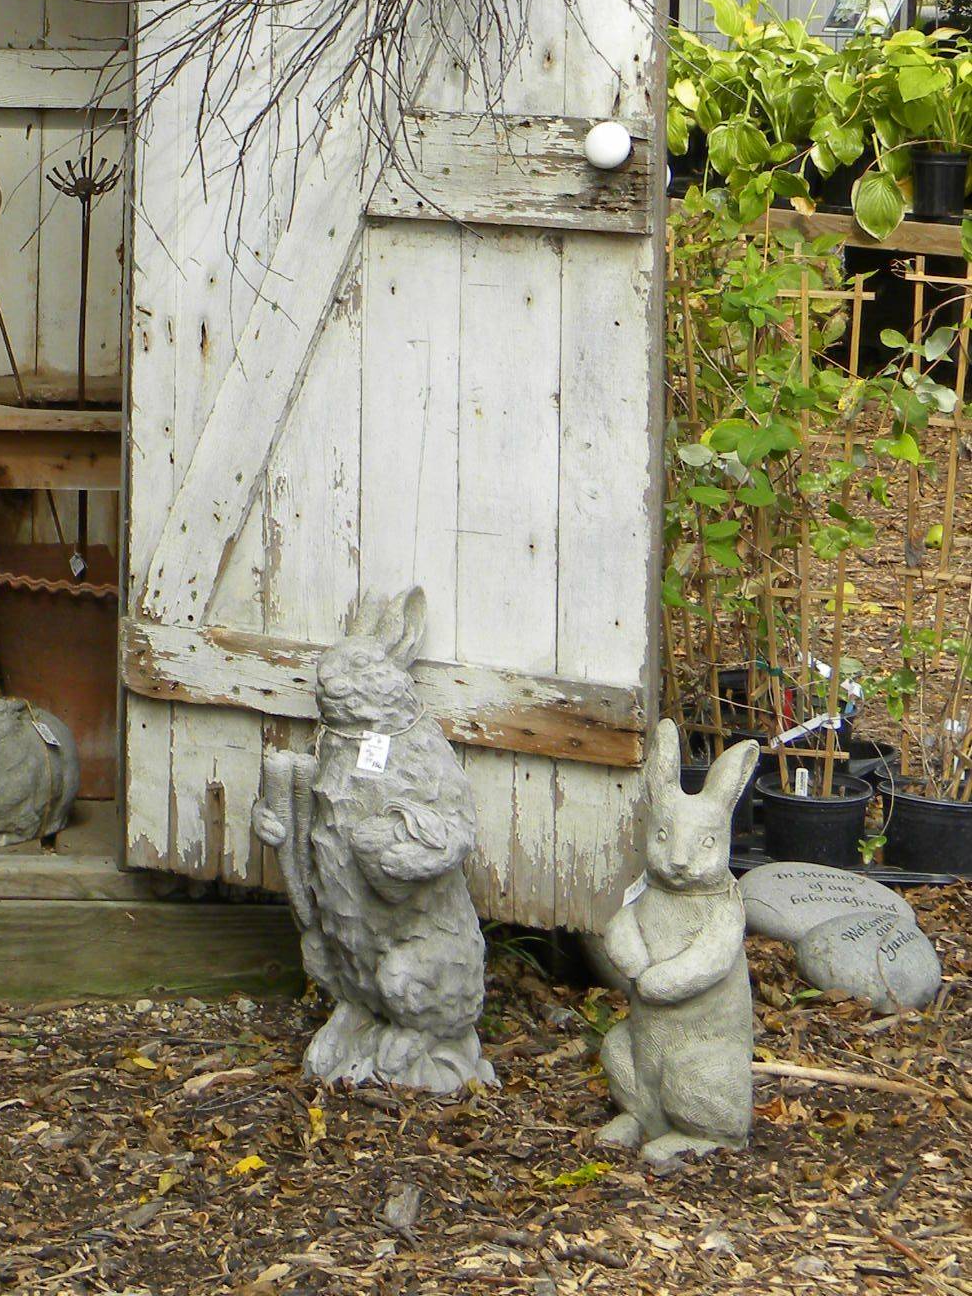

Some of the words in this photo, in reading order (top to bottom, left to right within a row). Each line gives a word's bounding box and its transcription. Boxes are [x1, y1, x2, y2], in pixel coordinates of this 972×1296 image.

[773, 872, 793, 880] In
[797, 871, 866, 885] Memory
[809, 882, 824, 892] of
[828, 884, 855, 893] our
[791, 894, 852, 905] beloved
[852, 896, 898, 913] friend
[841, 915, 888, 942] Welcome
[876, 921, 894, 936] our
